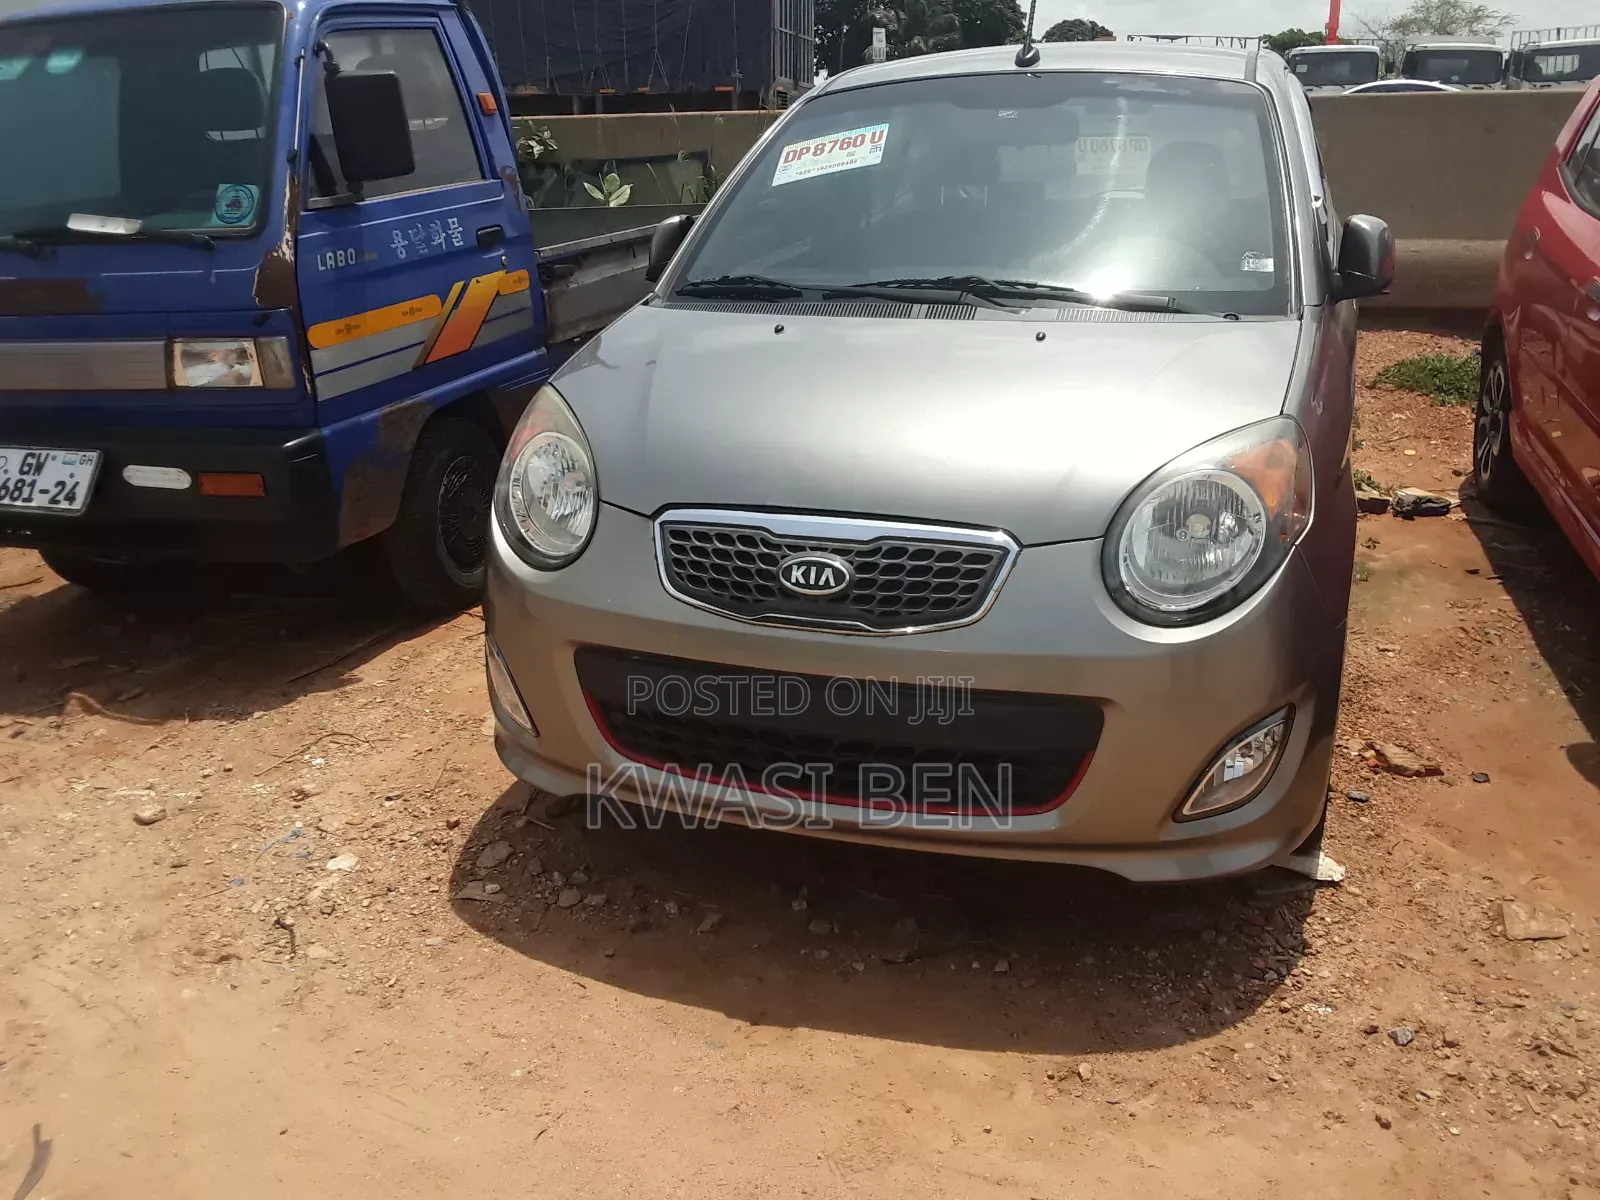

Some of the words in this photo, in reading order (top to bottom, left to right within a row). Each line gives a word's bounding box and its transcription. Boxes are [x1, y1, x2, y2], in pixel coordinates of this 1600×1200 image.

[783, 146, 812, 164] DP
[812, 133, 867, 157] 8760
[870, 129, 885, 145] U
[316, 247, 356, 272] LABO
[18, 452, 50, 477] GW
[79, 454, 94, 466] GH
[790, 564, 836, 587] KIA
